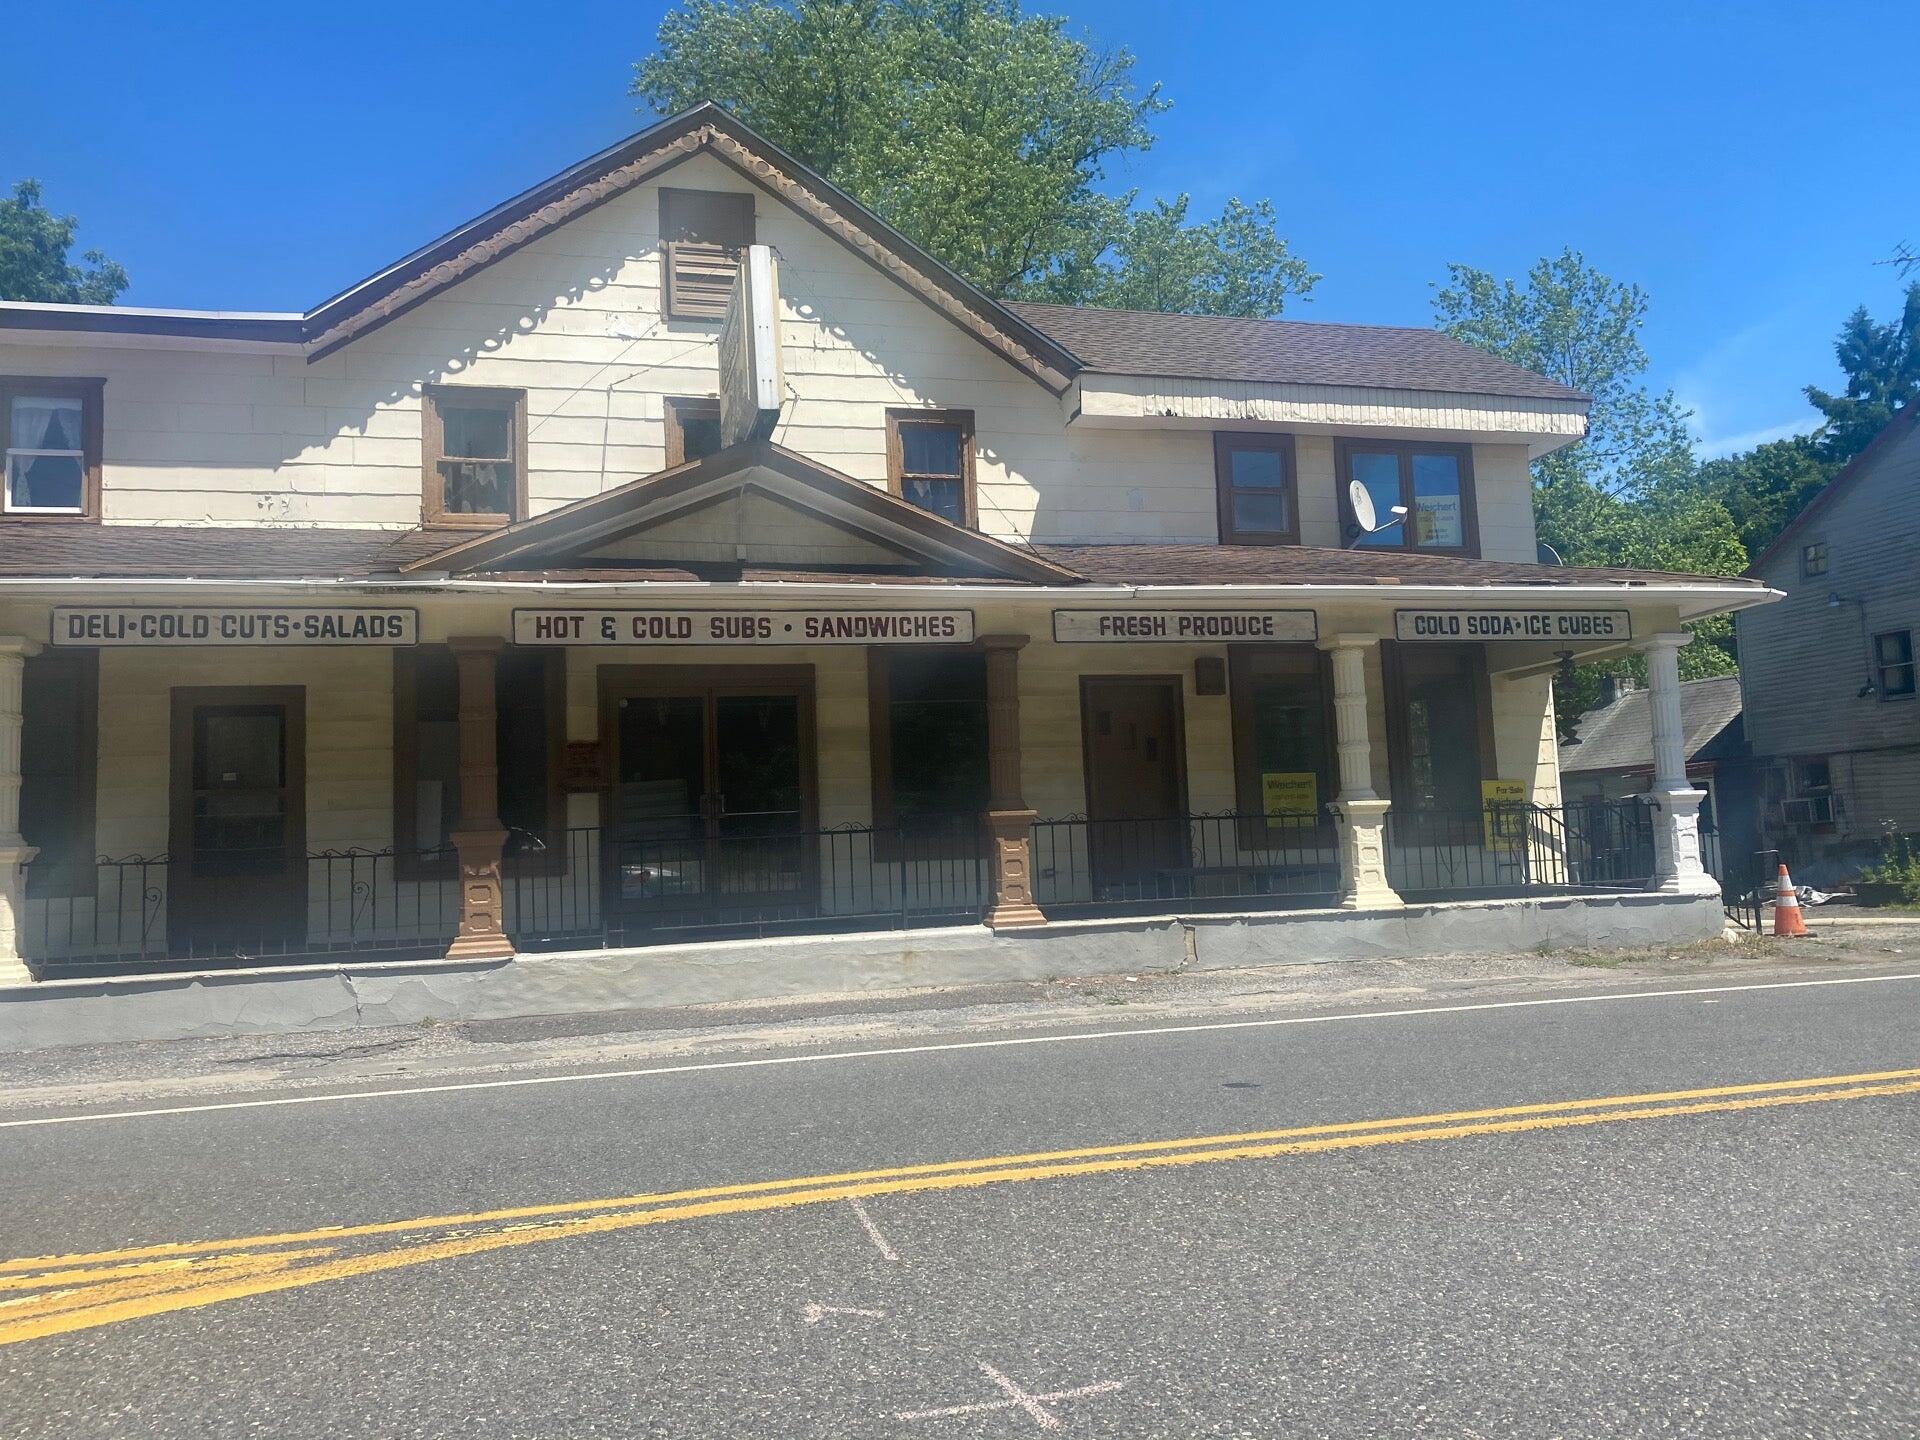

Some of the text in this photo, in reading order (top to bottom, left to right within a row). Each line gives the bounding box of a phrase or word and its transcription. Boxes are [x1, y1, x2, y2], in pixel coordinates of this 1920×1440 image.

[68, 614, 403, 639] DELI COLD CUTS SALADS
[535, 615, 956, 641] HOT & COLD SUBS SANDWICHES
[1099, 616, 1274, 636] FRESH PRODUCE
[1414, 615, 1614, 635] COLD SODA ICE CUBES
